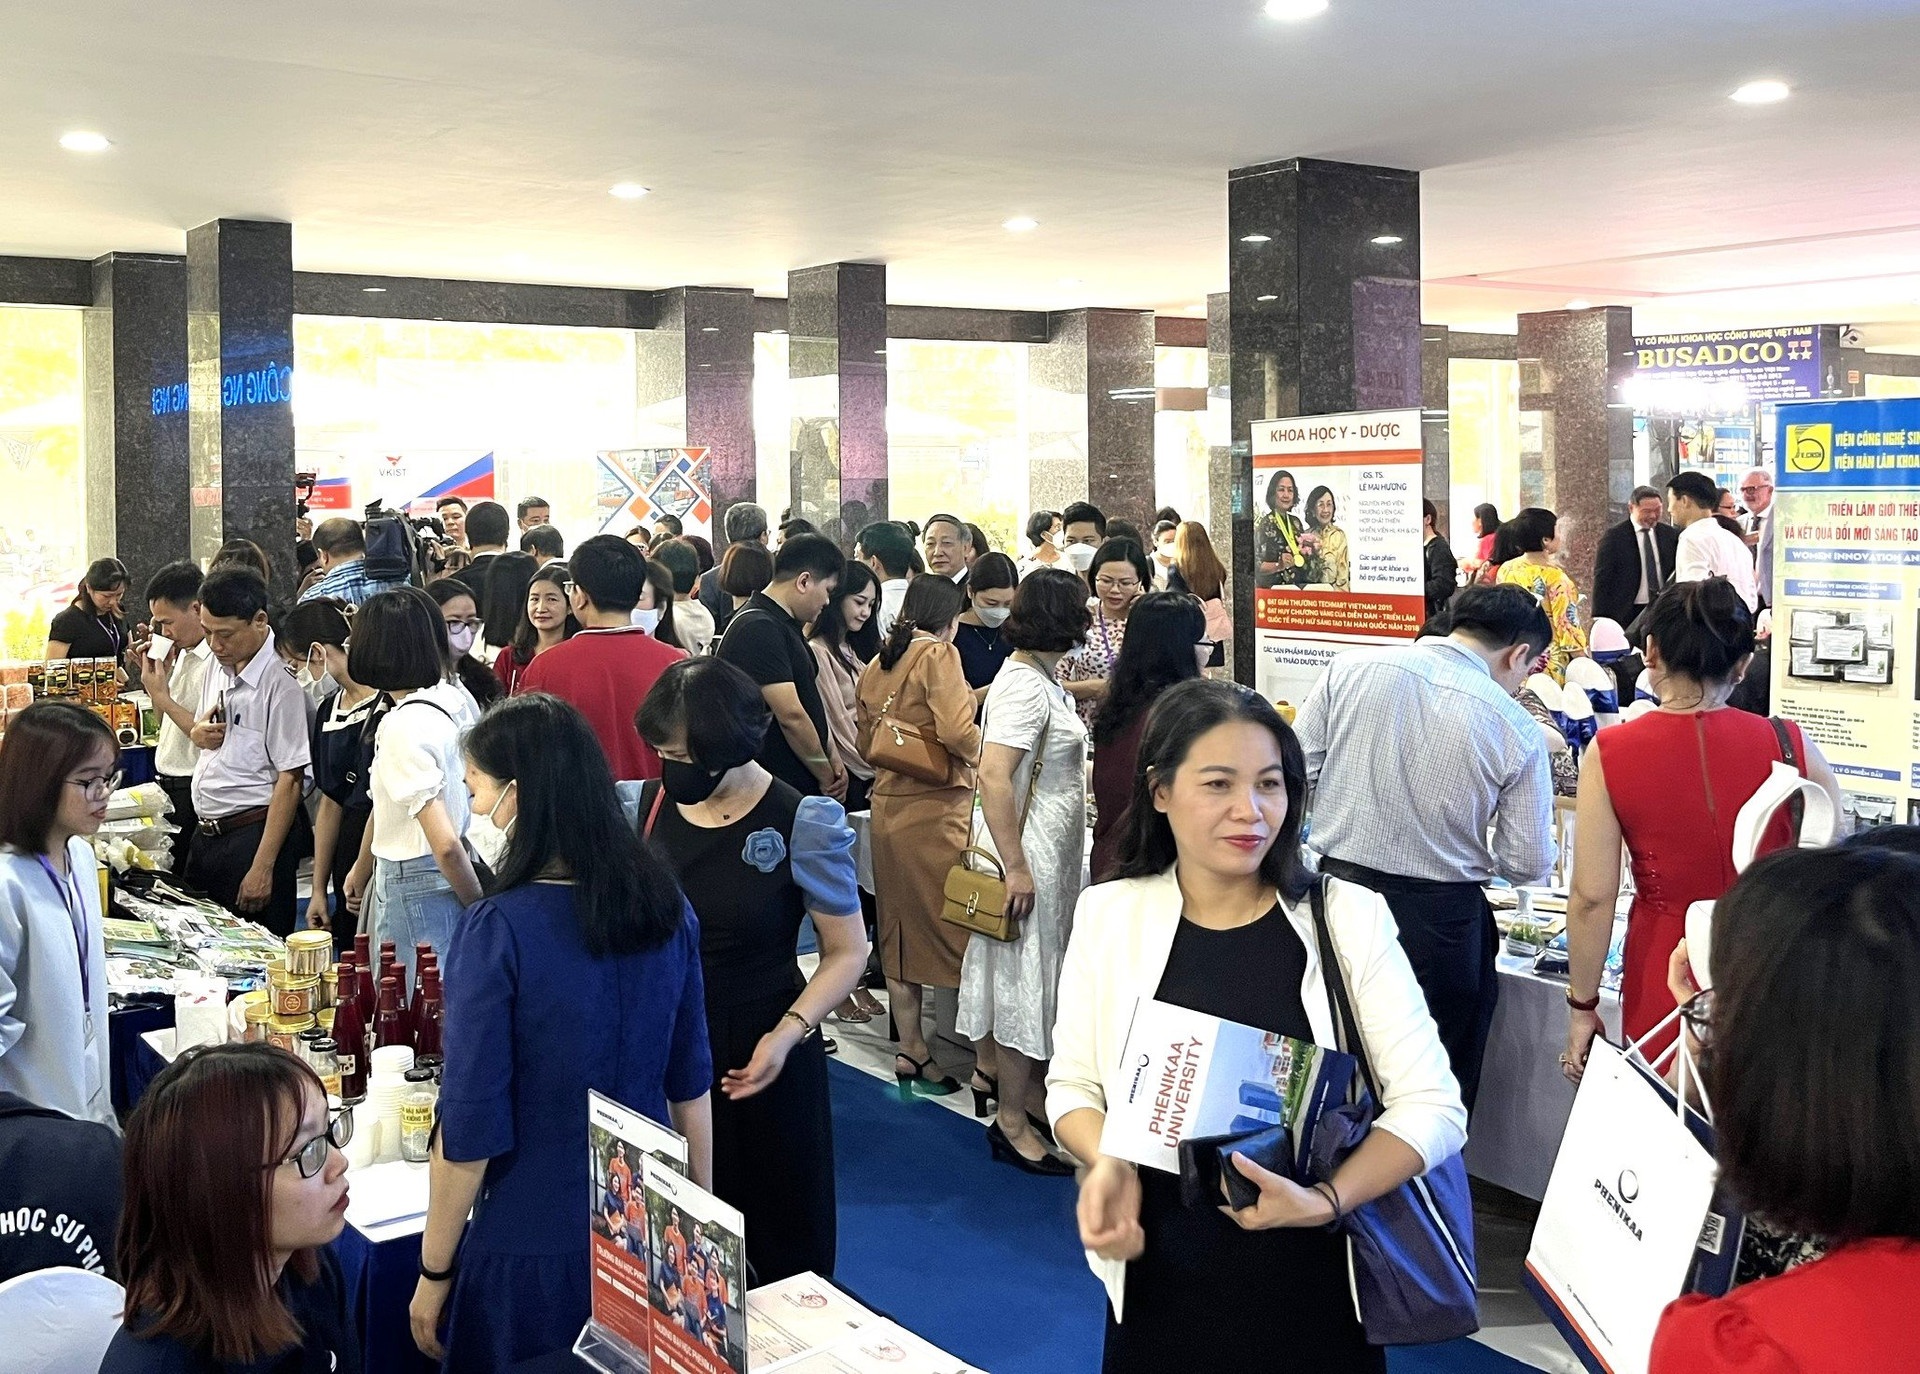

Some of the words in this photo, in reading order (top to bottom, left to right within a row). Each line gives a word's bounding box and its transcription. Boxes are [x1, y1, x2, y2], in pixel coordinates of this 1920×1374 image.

[1635, 338, 1645, 346] TY
[1681, 335, 1704, 344] KHOA
[1793, 326, 1813, 336] NAM
[1637, 341, 1784, 370] BUSADCO
[1270, 428, 1305, 443] KHOA
[1309, 426, 1337, 444] HỌC
[1339, 426, 1348, 439] Y
[1360, 422, 1400, 441] DƯỢC
[1835, 431, 1855, 450] VIỆN
[1882, 429, 1906, 449] NGHỆ
[1834, 453, 1855, 472] VIỆN
[1901, 528, 1919, 545] TẠO
[1792, 551, 1832, 561] WOMEN
[1833, 551, 1900, 562] INNOVATION
[1348, 602, 1377, 611] VIETNAM
[1378, 603, 1393, 612] 2015
[1404, 624, 1420, 632] 2018
[1148, 1042, 1184, 1135] PHENIKAA
[1164, 1036, 1203, 1148] UNIVERSITY
[1593, 1178, 1643, 1242] PHENIKAA
[0, 1207, 47, 1236] HỌC
